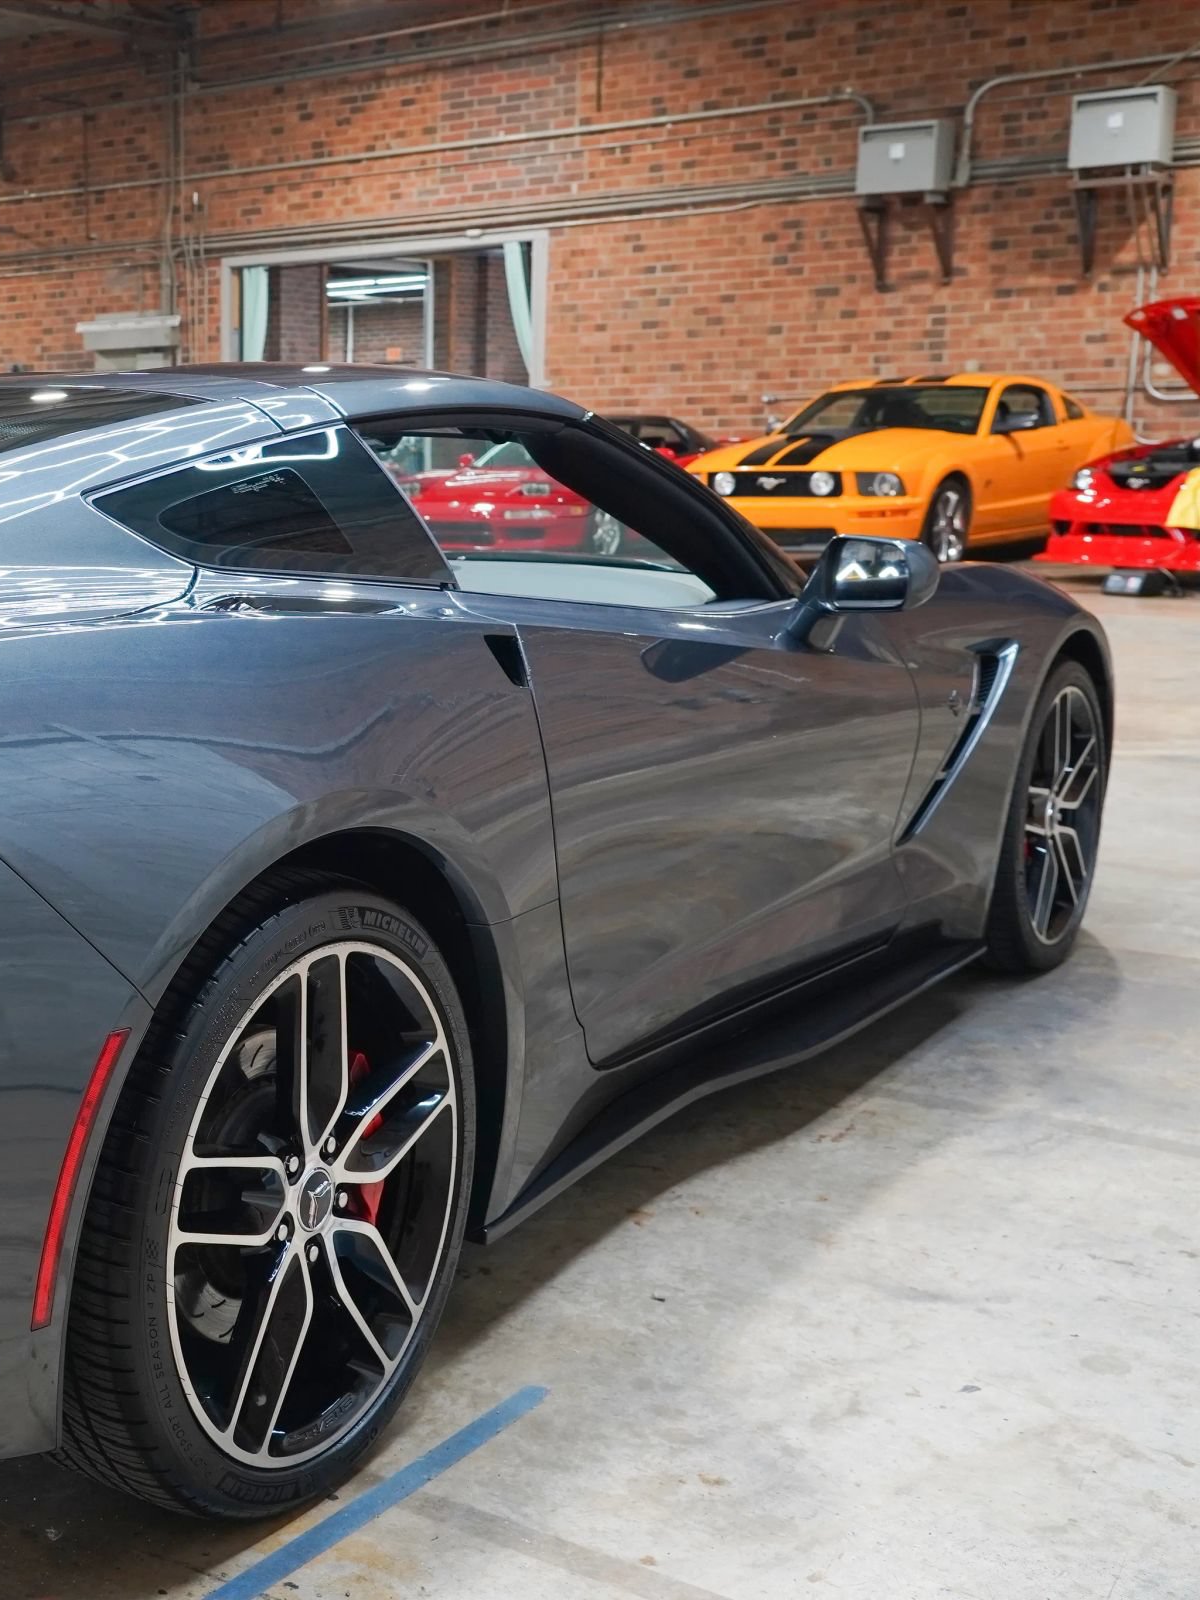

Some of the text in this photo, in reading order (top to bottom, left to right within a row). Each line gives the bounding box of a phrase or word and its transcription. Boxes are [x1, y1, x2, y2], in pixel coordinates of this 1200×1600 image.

[363, 909, 429, 957] MICHELIN
[147, 1316, 165, 1380] SEASON
[159, 1383, 173, 1409] ALL
[168, 1416, 193, 1452] SPORT
